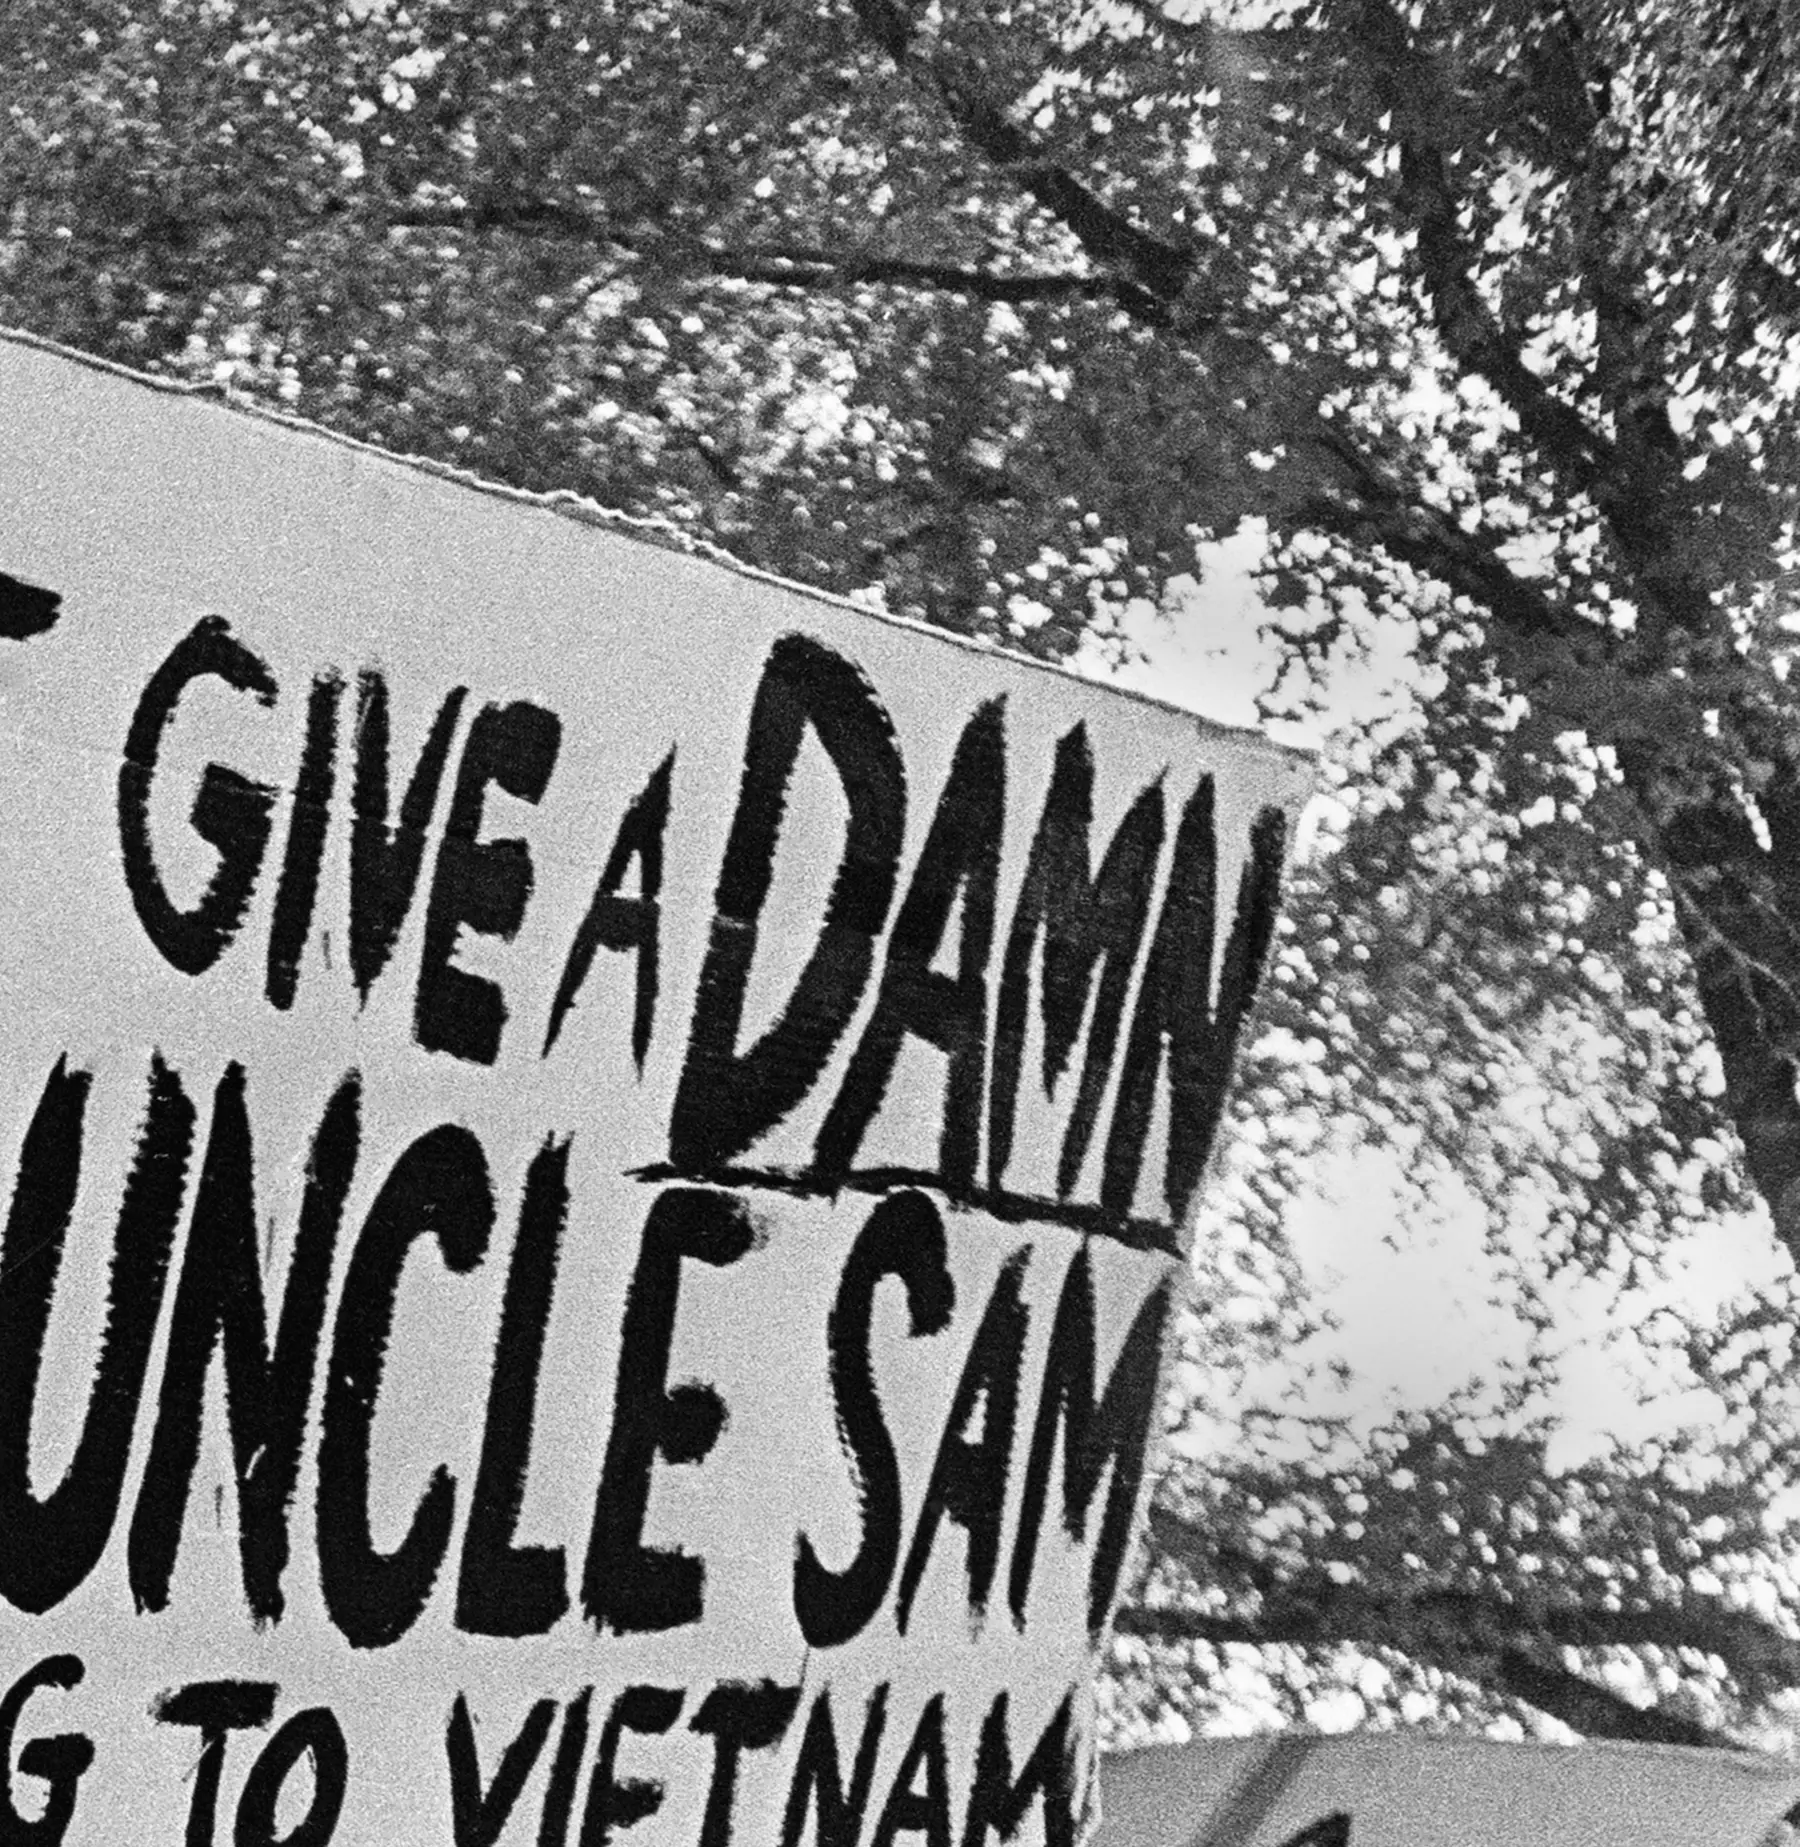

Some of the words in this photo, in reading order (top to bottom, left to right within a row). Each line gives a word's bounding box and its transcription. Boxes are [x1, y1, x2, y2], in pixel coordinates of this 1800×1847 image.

[117, 614, 563, 1067] GIVE
[543, 742, 677, 1083] A
[668, 632, 1287, 1235] DAMN
[792, 1187, 1173, 1650] SAM
